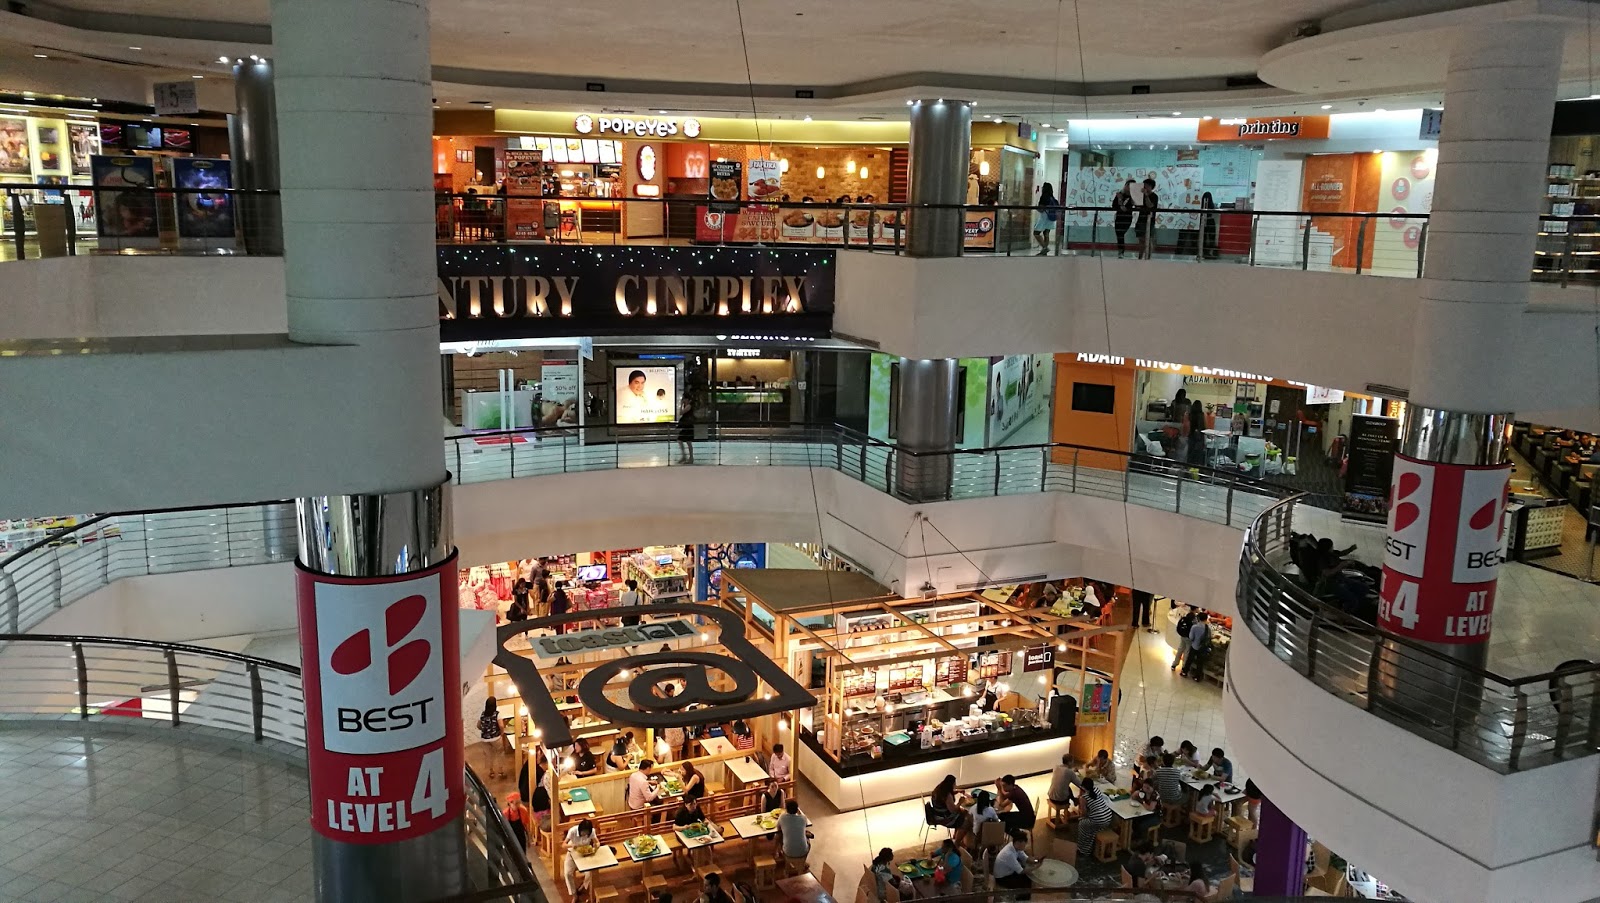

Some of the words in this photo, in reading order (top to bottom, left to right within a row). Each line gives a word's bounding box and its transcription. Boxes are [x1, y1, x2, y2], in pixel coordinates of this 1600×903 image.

[1239, 119, 1300, 137] printing
[614, 274, 807, 316] CINEPLEX
[1188, 375, 1210, 384] ADAM
[1391, 580, 1419, 630] 4
[1465, 591, 1488, 612] AT
[539, 628, 645, 655] toast
[338, 697, 434, 733] BEST
[327, 799, 412, 833] LEVEL
[410, 746, 450, 820] 4
[347, 767, 384, 797] AT
